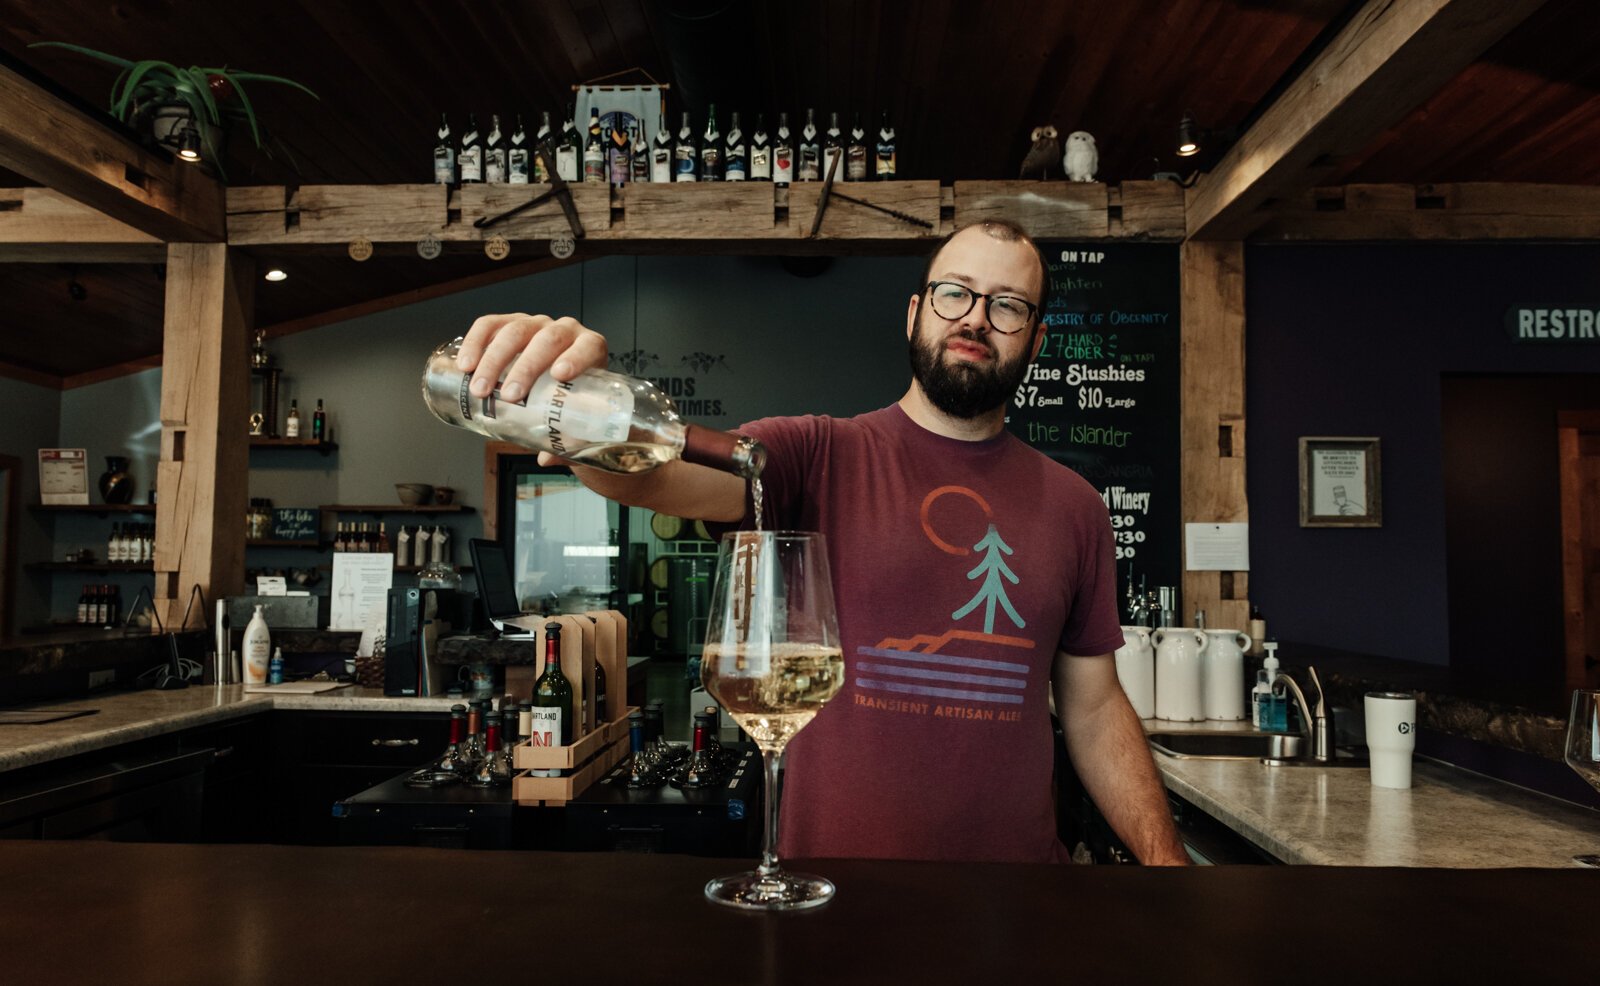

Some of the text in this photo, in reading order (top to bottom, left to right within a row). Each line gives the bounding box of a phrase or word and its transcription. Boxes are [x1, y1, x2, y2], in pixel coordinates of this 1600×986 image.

[1061, 250, 1105, 264] ON TAP
[1043, 312, 1085, 326] PESTRY
[1090, 313, 1105, 325] OF
[1068, 333, 1104, 347] HARD
[1065, 346, 1105, 360] CIDER
[1066, 363, 1146, 386] Slushies
[1014, 384, 1136, 410] $7 Small $10 Large
[547, 381, 574, 453] HARTLAND
[1027, 421, 1134, 448] the islander
[1111, 486, 1152, 515] Winery
[854, 693, 929, 715] TRANSIENT
[934, 704, 994, 720] ARTISAN
